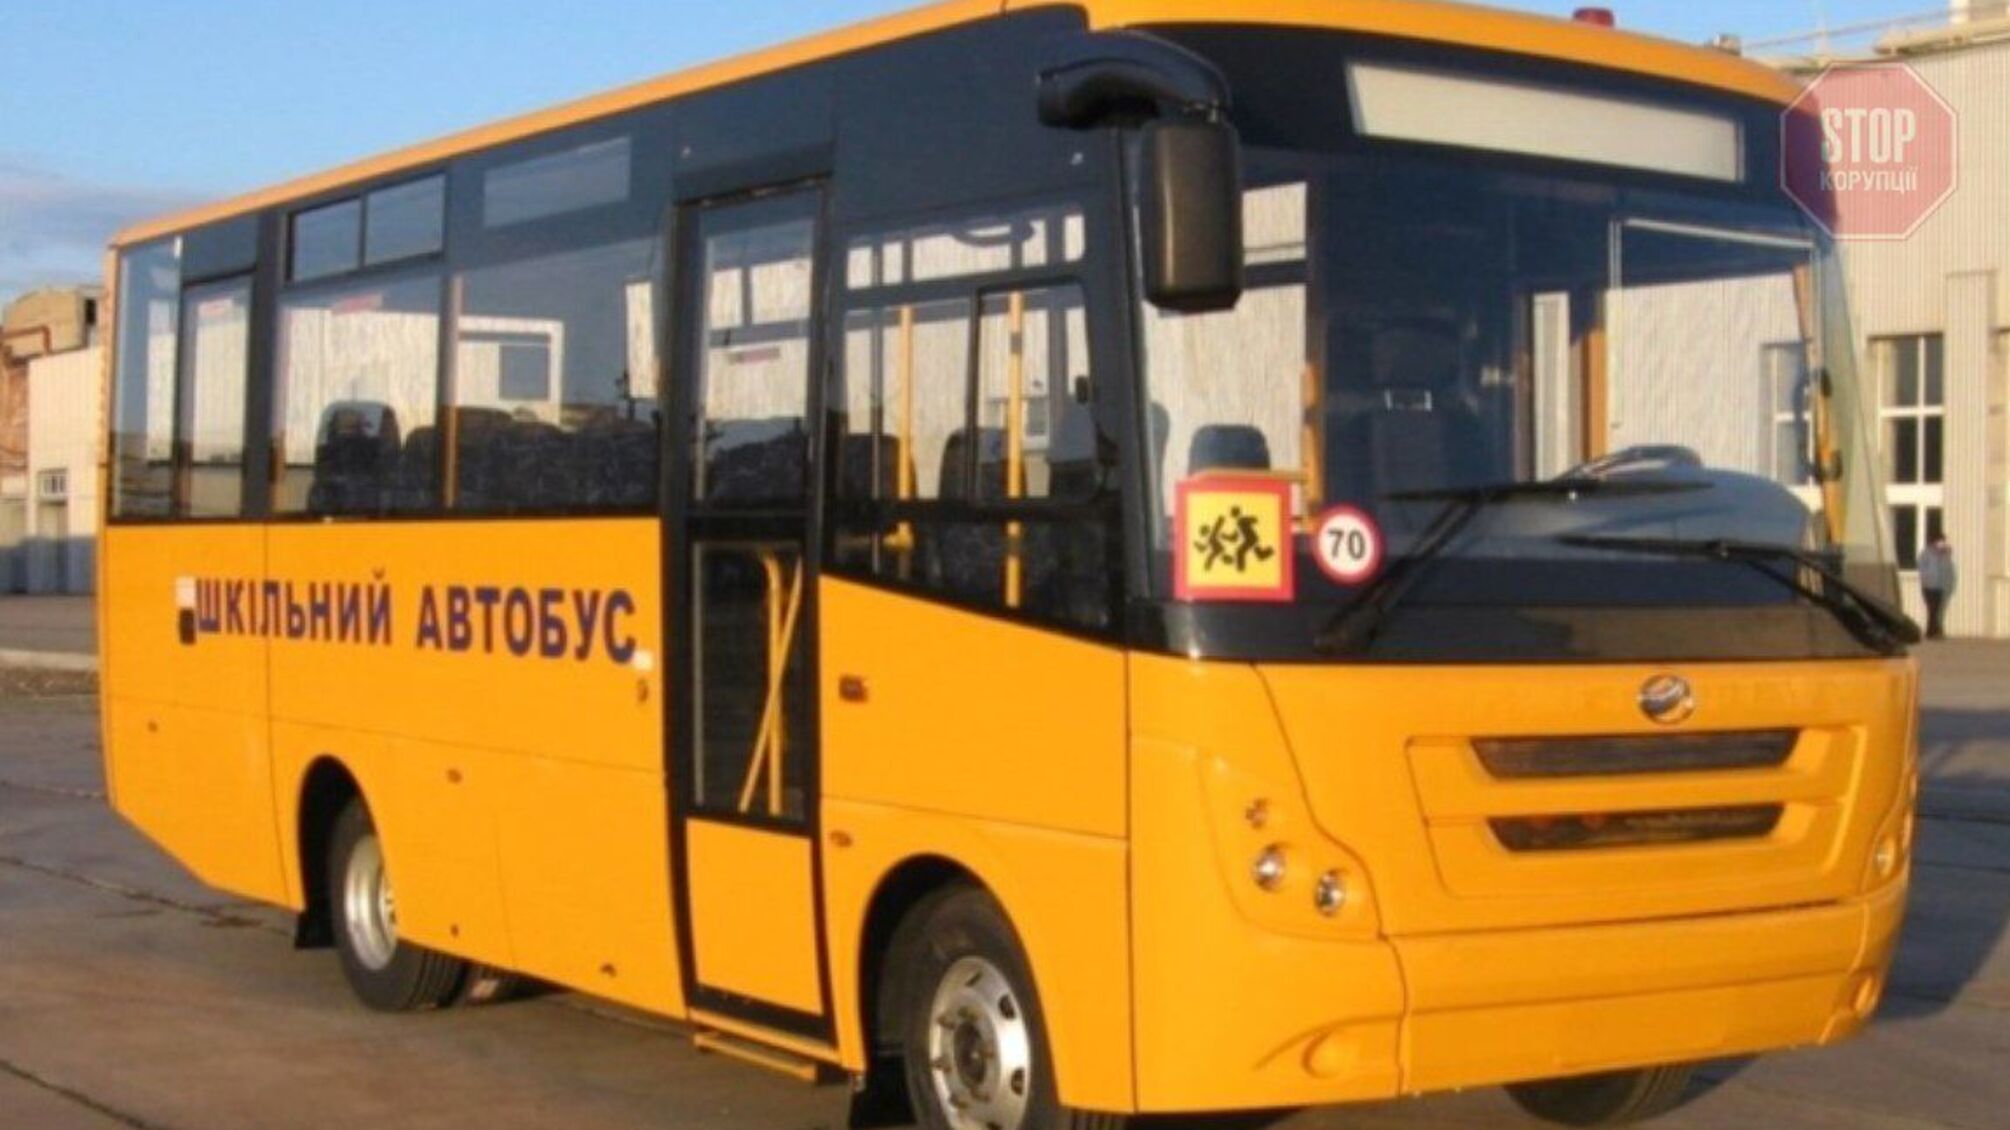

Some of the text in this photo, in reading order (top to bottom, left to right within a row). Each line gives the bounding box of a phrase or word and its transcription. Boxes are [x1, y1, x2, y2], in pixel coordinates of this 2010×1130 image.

[1327, 529, 1366, 560] 70
[195, 568, 638, 665] ШКІЛЬНИЙ АВТОБУС
